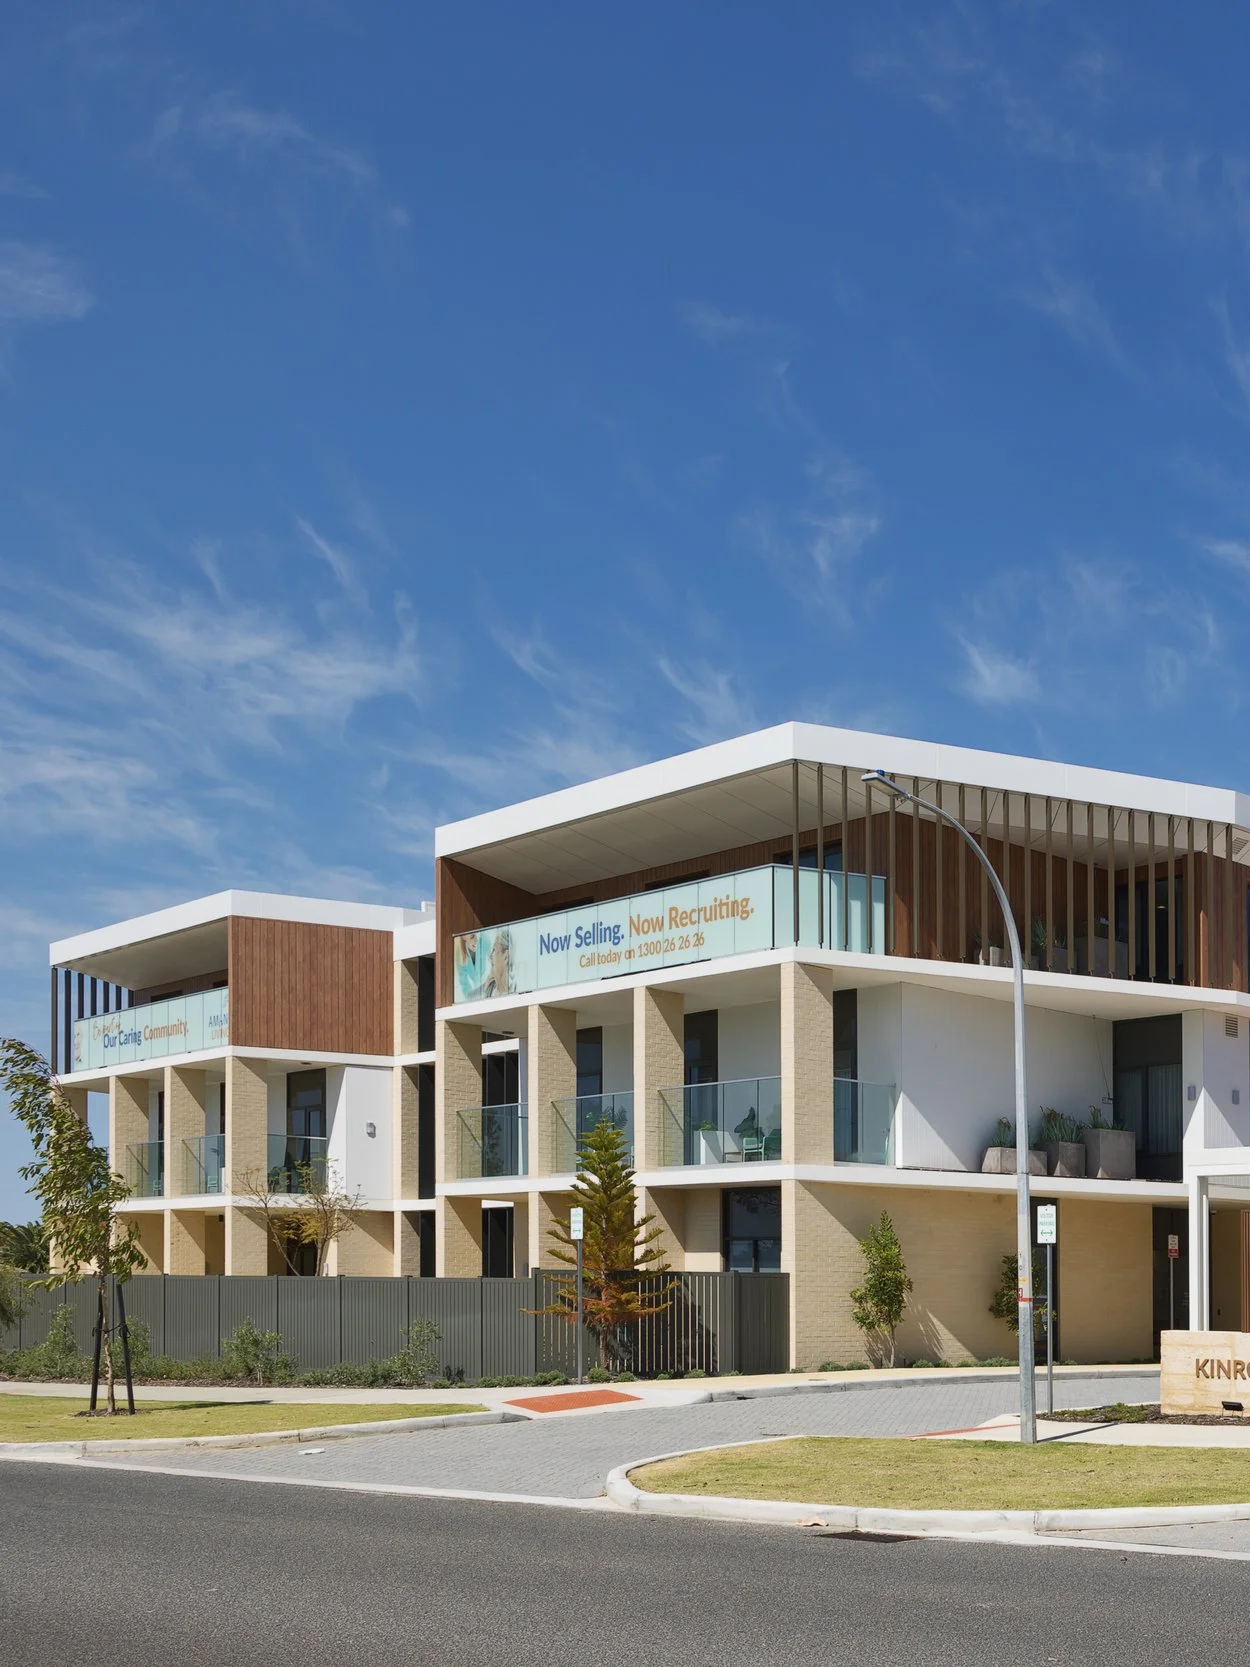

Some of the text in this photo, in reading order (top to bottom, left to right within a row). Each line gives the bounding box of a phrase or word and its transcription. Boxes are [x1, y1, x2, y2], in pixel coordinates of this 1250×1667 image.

[539, 895, 754, 956] Now Selling. Now Recruiting.
[579, 931, 705, 969] Call today on 1300 26 26 26
[103, 1032, 117, 1049] Our
[119, 1027, 142, 1046] Caring
[144, 1019, 188, 1040] Community.
